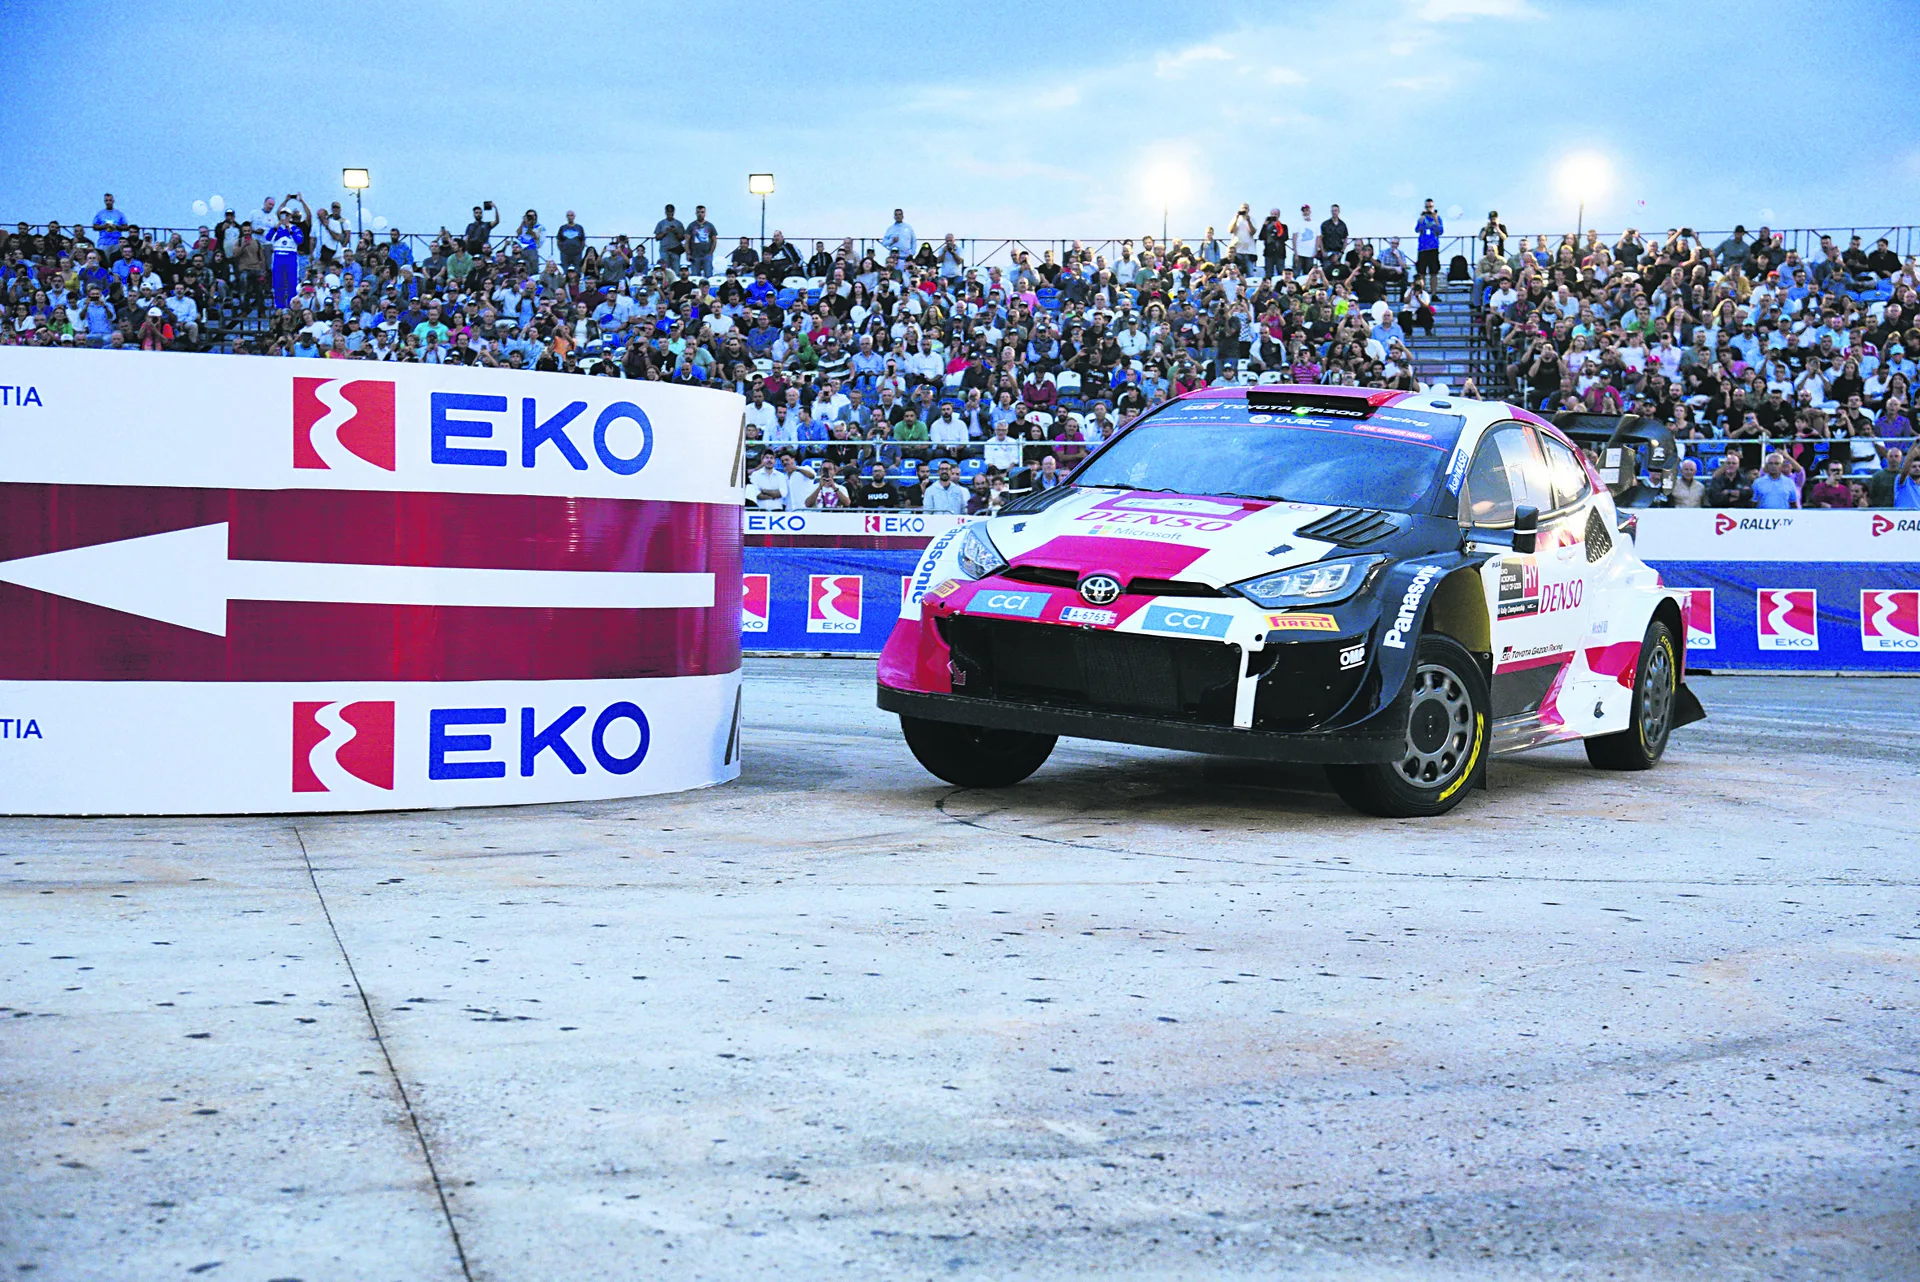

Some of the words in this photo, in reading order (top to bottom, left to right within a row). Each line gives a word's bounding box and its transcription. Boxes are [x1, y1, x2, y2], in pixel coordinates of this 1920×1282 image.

[1275, 416, 1333, 427] WRC
[431, 392, 653, 475] EKO
[749, 516, 806, 531] EKO
[885, 517, 925, 533] EKO
[1074, 511, 1232, 532] DENSO
[1114, 527, 1183, 541] Microsoft
[1540, 579, 1583, 614] DENSO
[1382, 565, 1442, 650] Panasonic
[1072, 611, 1107, 622] A-6765
[1269, 616, 1333, 629] PIRELLI
[822, 622, 857, 630] EKO
[1775, 638, 1814, 647] EKO
[1879, 639, 1919, 648] EKO
[1339, 647, 1366, 666] OMP
[429, 701, 650, 780] EKO
